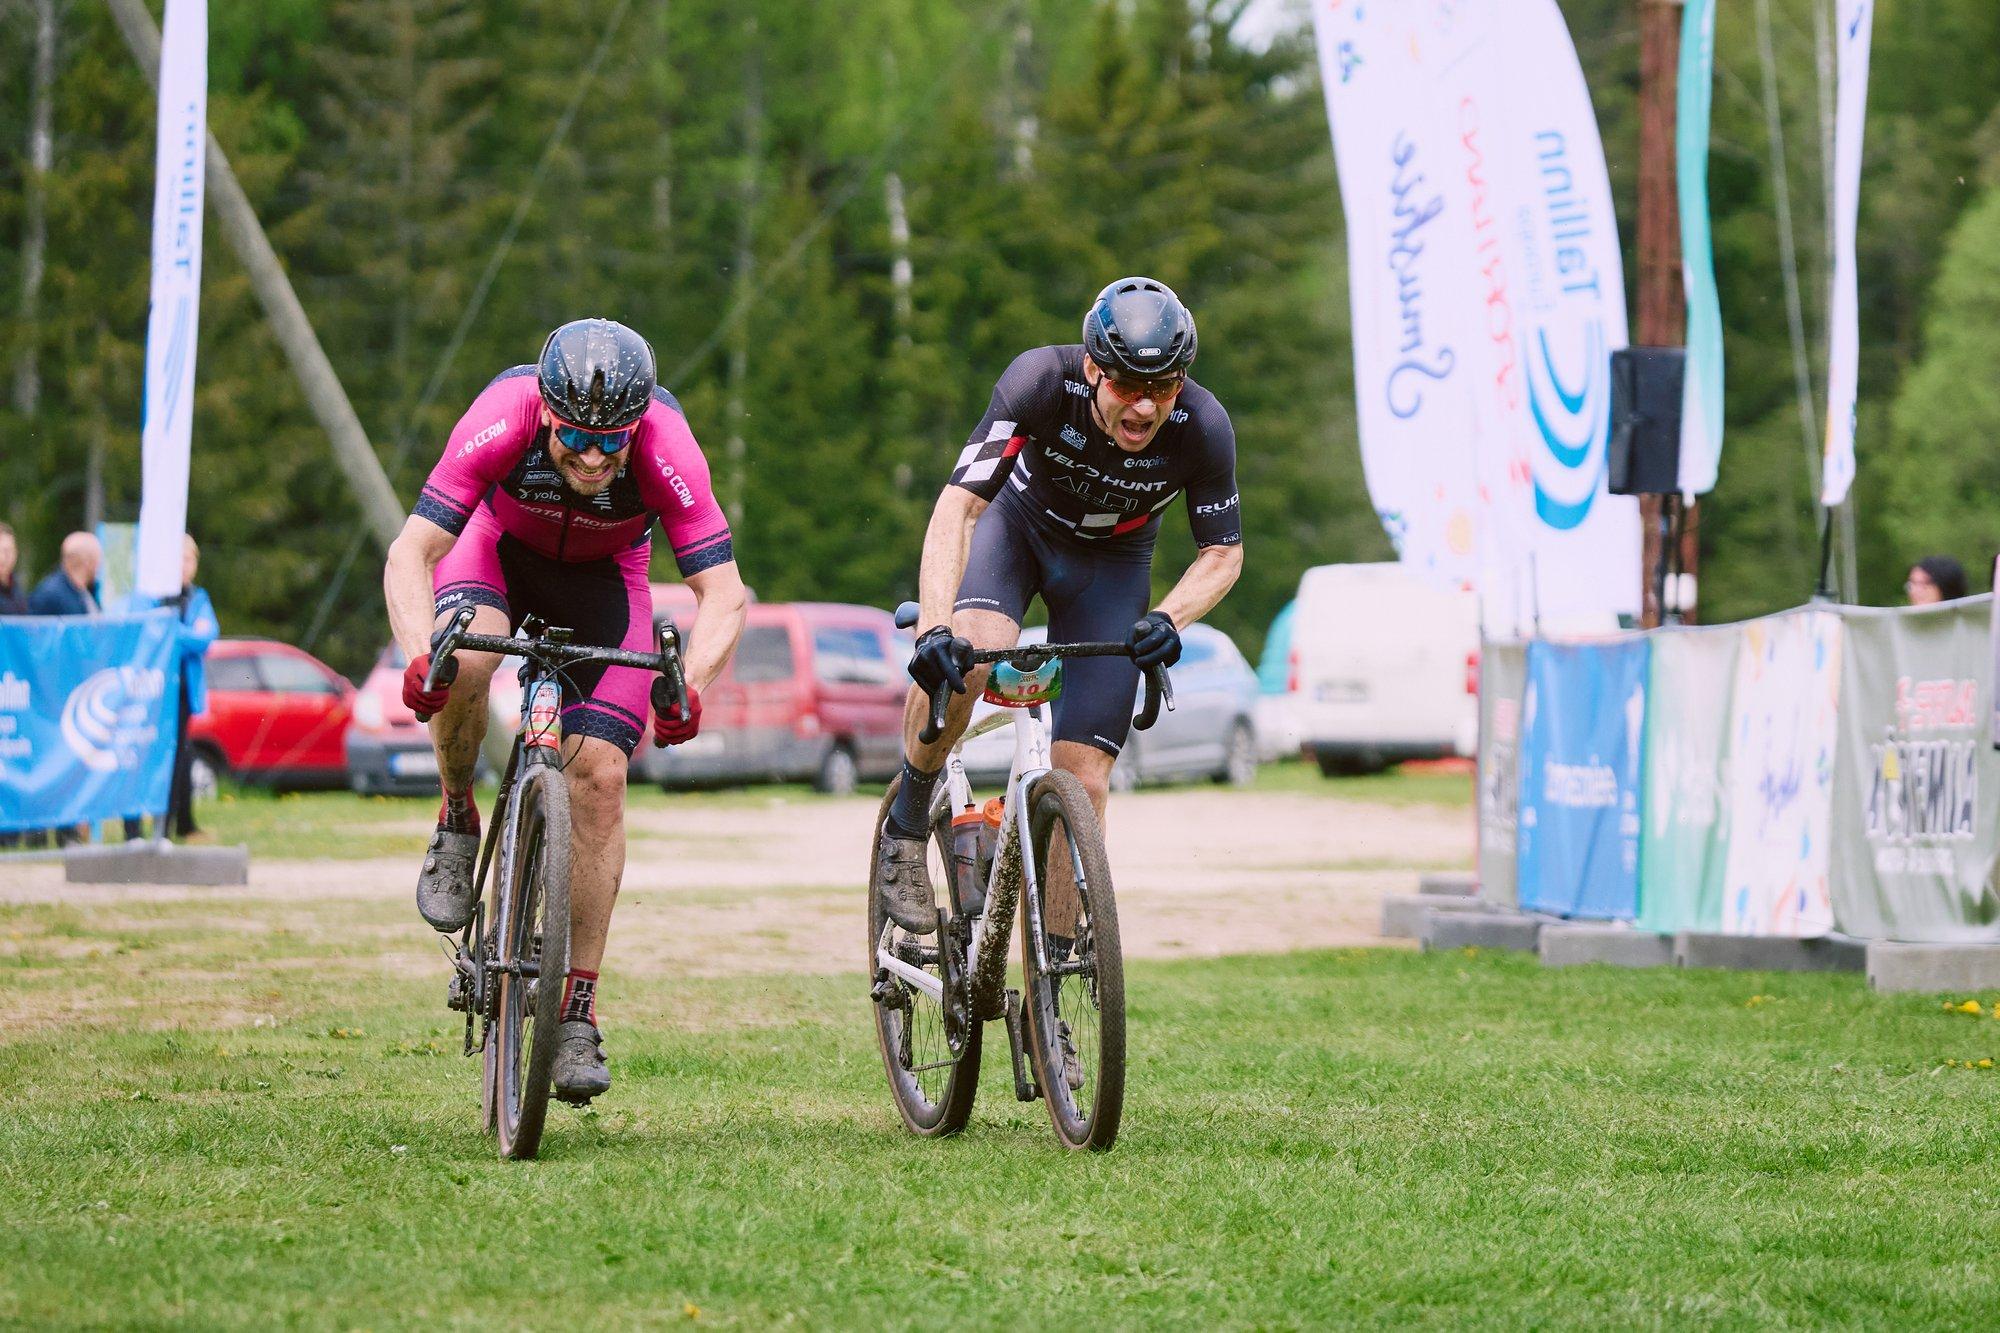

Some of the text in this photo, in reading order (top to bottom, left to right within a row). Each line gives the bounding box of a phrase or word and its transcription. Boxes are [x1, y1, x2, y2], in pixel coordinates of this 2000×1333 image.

[474, 418, 507, 448] CCRM
[534, 490, 562, 500] yolo
[669, 475, 696, 508] CCRM
[1101, 474, 1168, 492] HUNT
